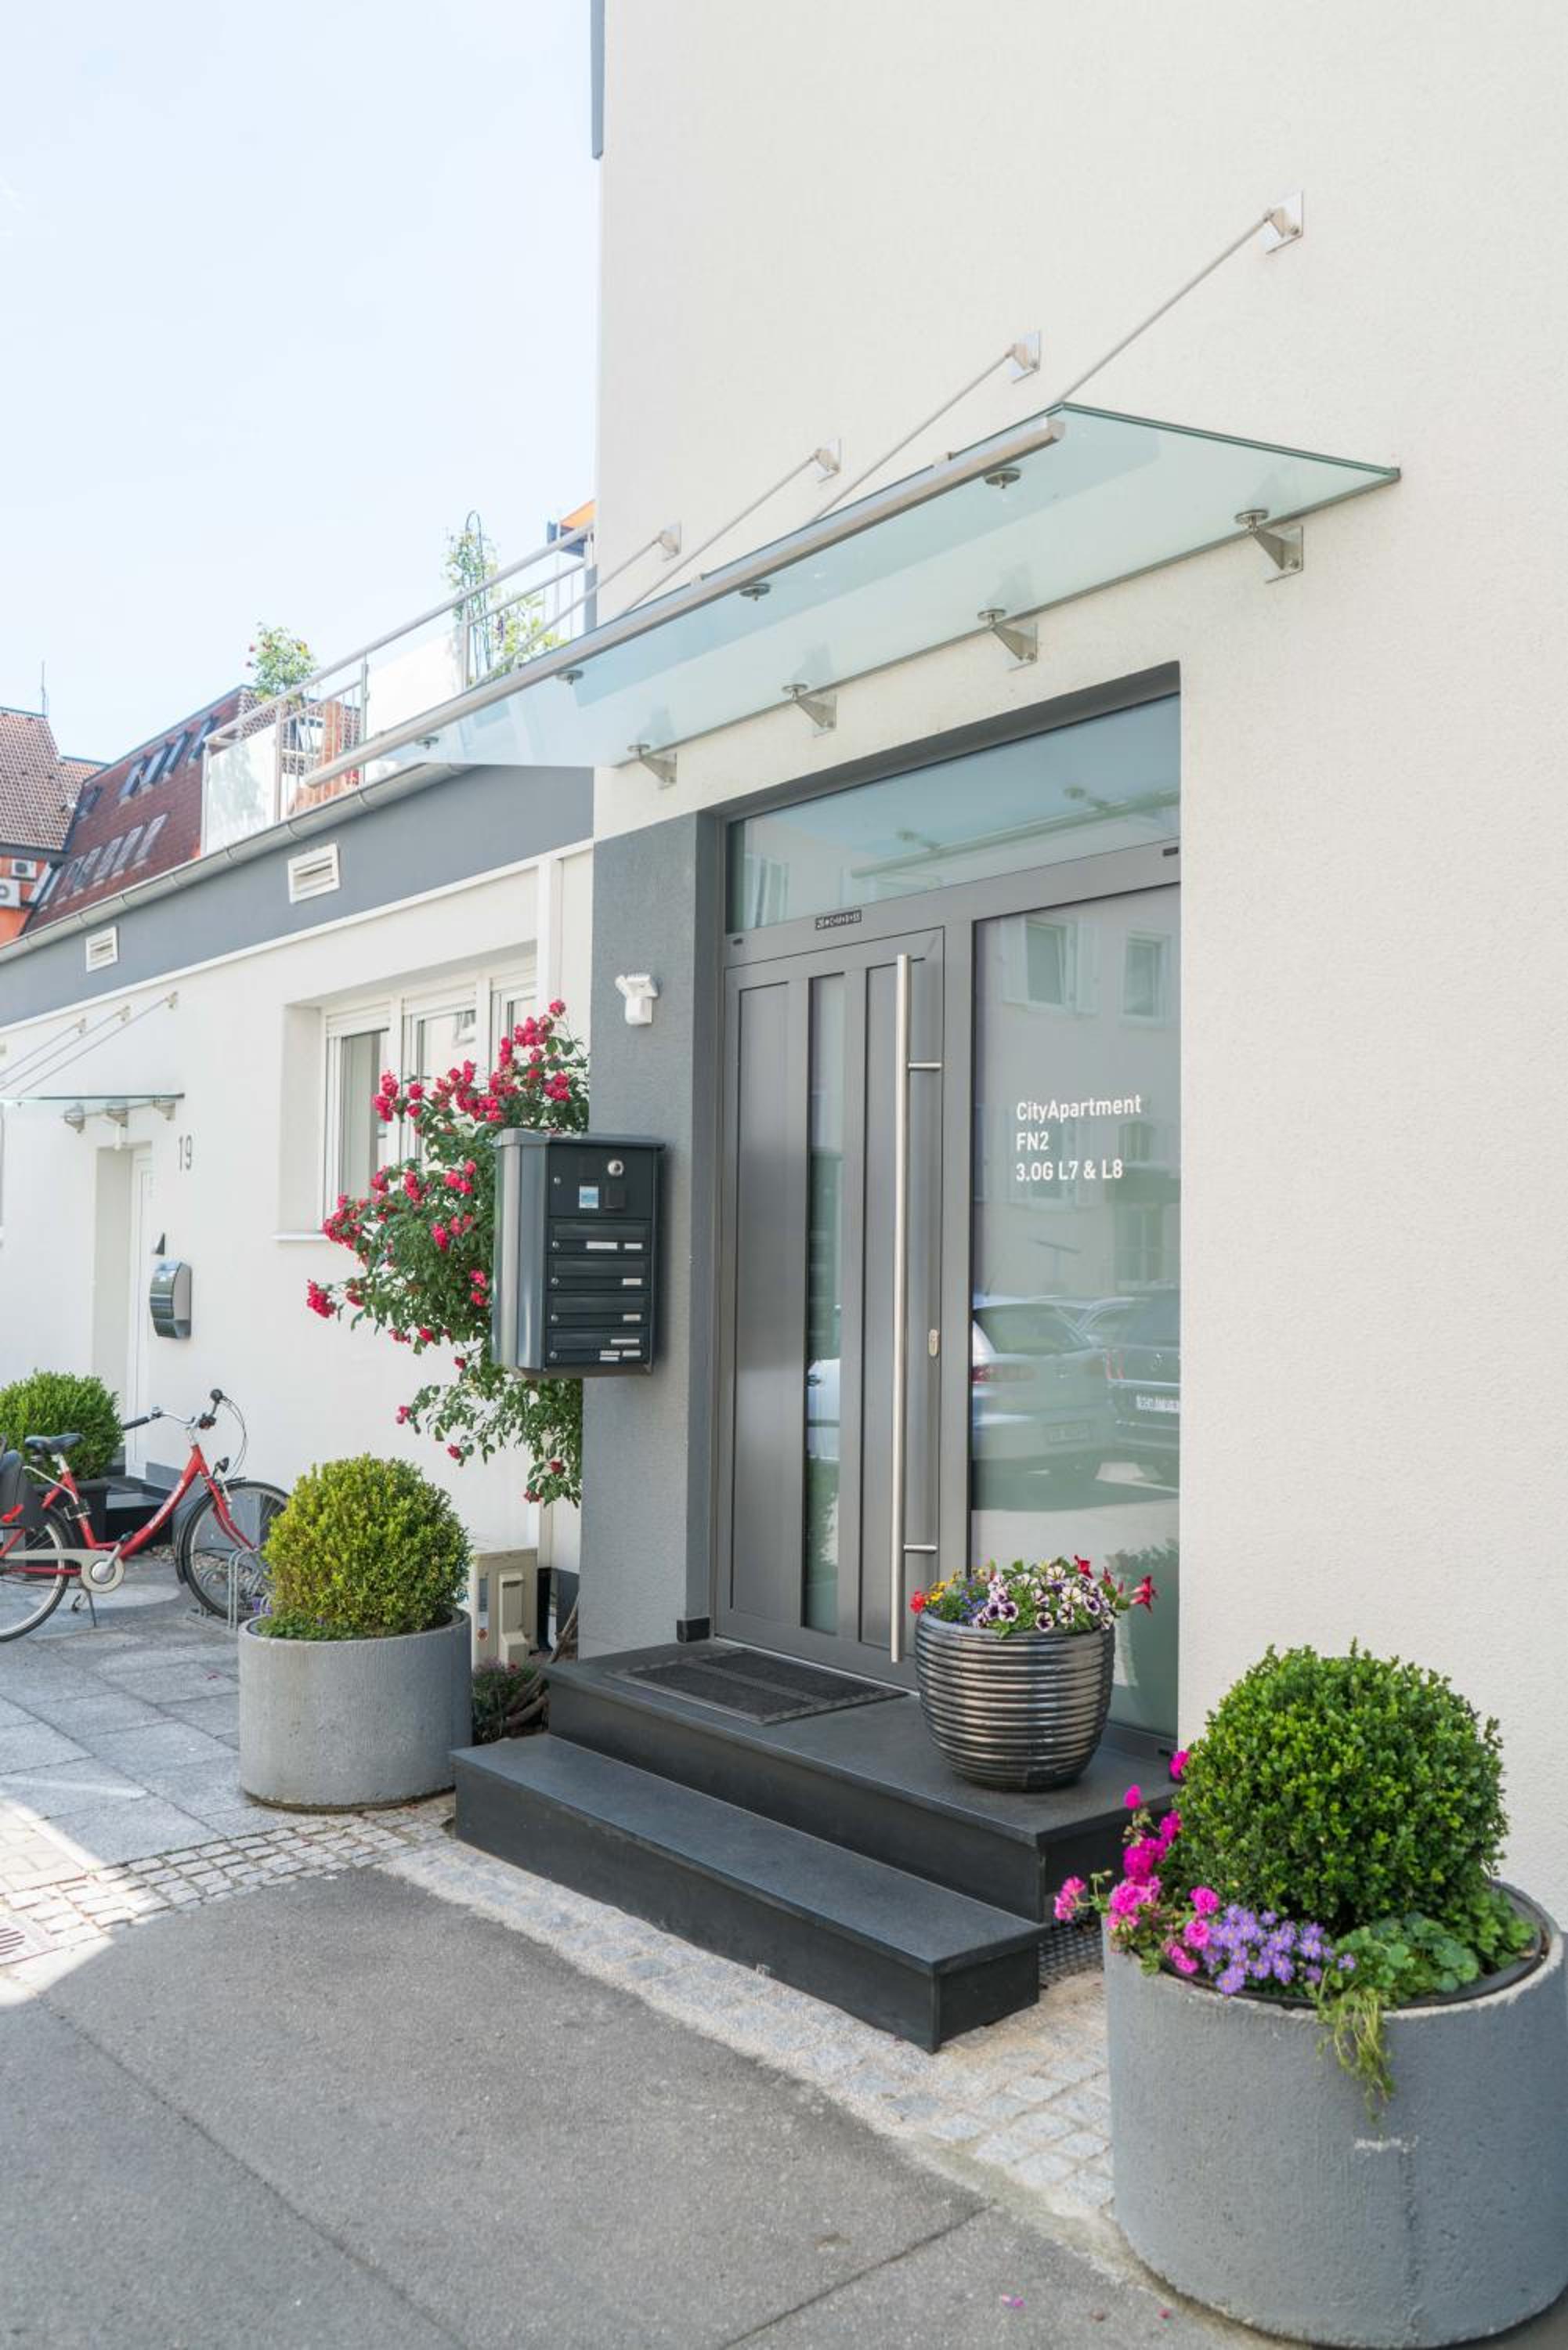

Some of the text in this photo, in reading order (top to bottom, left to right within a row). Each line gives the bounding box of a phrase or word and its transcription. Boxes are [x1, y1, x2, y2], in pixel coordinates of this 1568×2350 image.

[1016, 1094, 1142, 1124] CityApartment
[178, 1134, 193, 1172] 19
[1016, 1130, 1049, 1152] FN2
[1058, 1160, 1078, 1180] L7
[1083, 1159, 1097, 1180] &
[1102, 1159, 1123, 1179] L8
